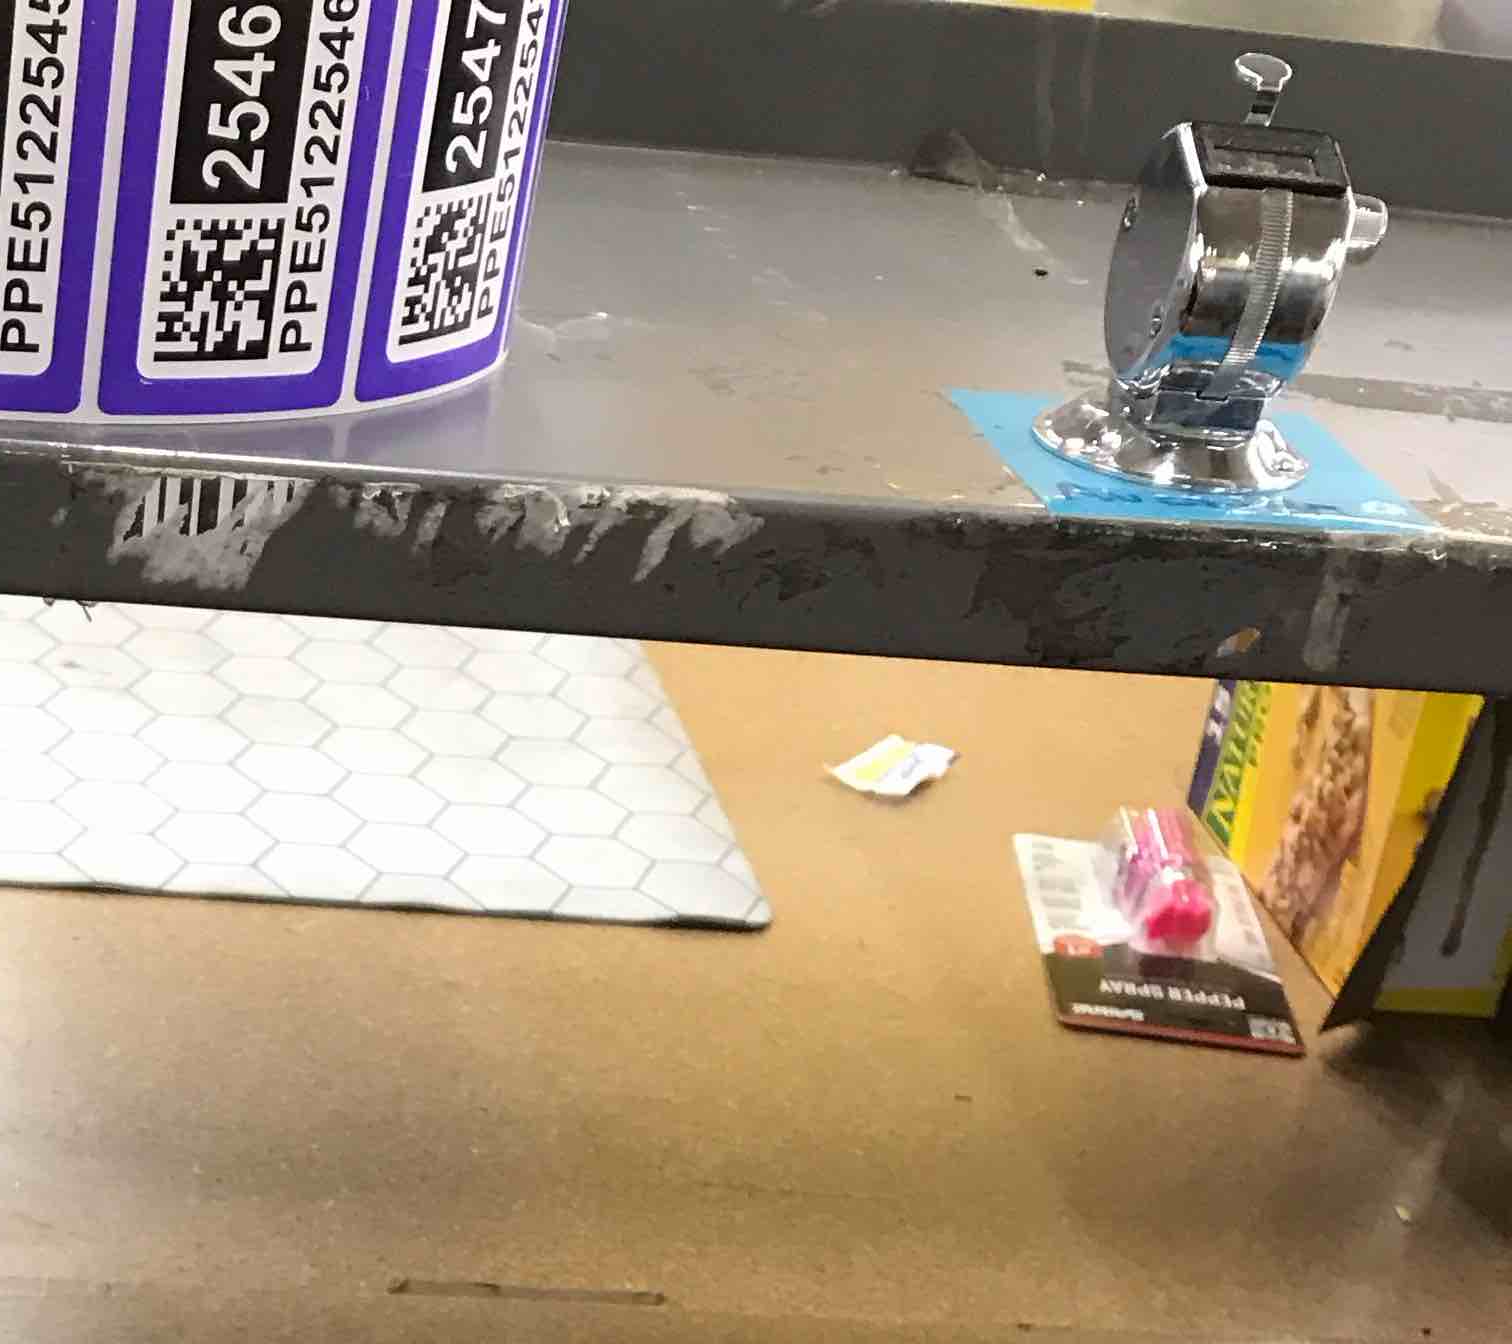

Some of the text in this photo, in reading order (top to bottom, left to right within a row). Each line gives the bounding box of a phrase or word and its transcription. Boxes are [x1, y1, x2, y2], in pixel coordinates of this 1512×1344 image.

[202, 4, 281, 190] 2546
[279, 0, 359, 352] PPE5122546
[445, 0, 506, 175] 2547
[476, 0, 544, 320] PPE512254
[1098, 978, 1246, 1011] PEPPER SPRAY
